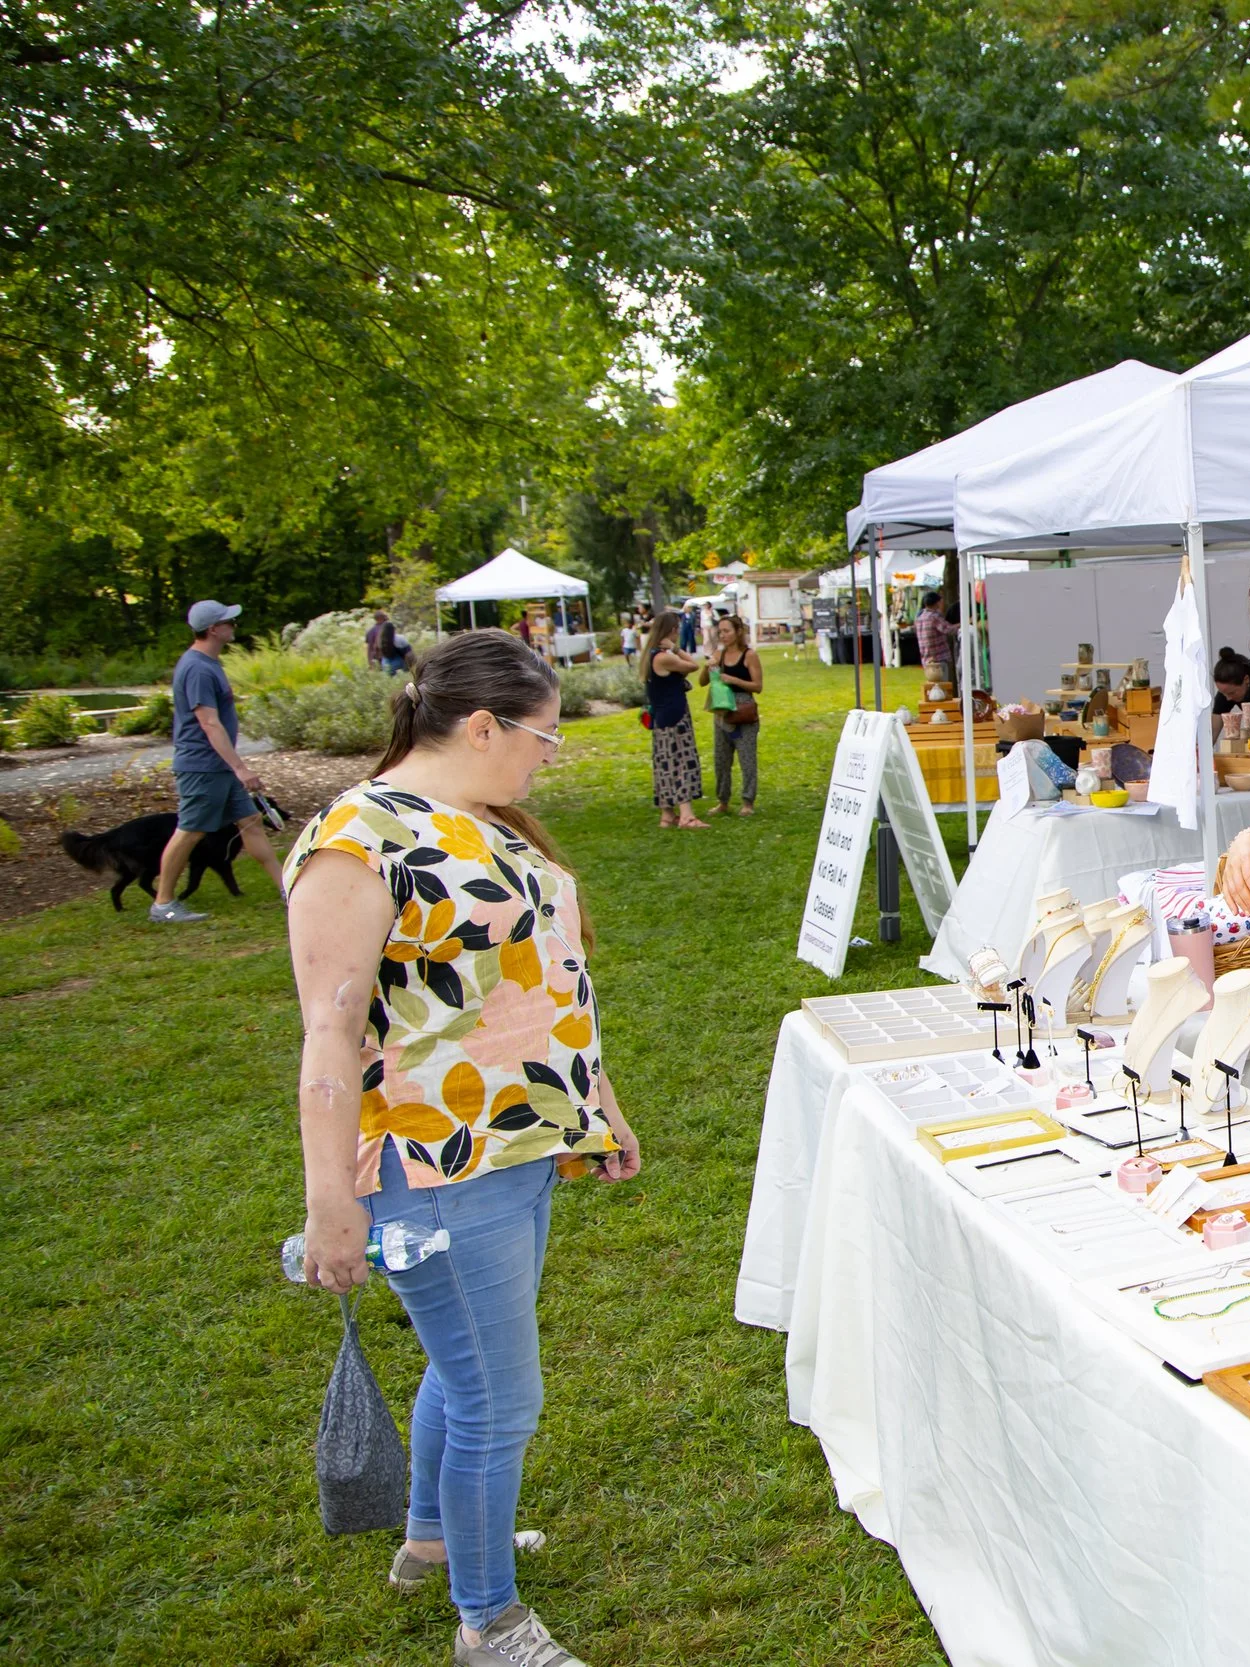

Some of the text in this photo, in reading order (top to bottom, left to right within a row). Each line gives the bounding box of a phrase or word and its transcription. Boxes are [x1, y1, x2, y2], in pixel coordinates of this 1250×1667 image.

[830, 791, 862, 818] Sign Up for
[826, 826, 853, 851] Adult and
[817, 860, 848, 888] Kid Fall Art
[813, 894, 838, 921] Classes!
